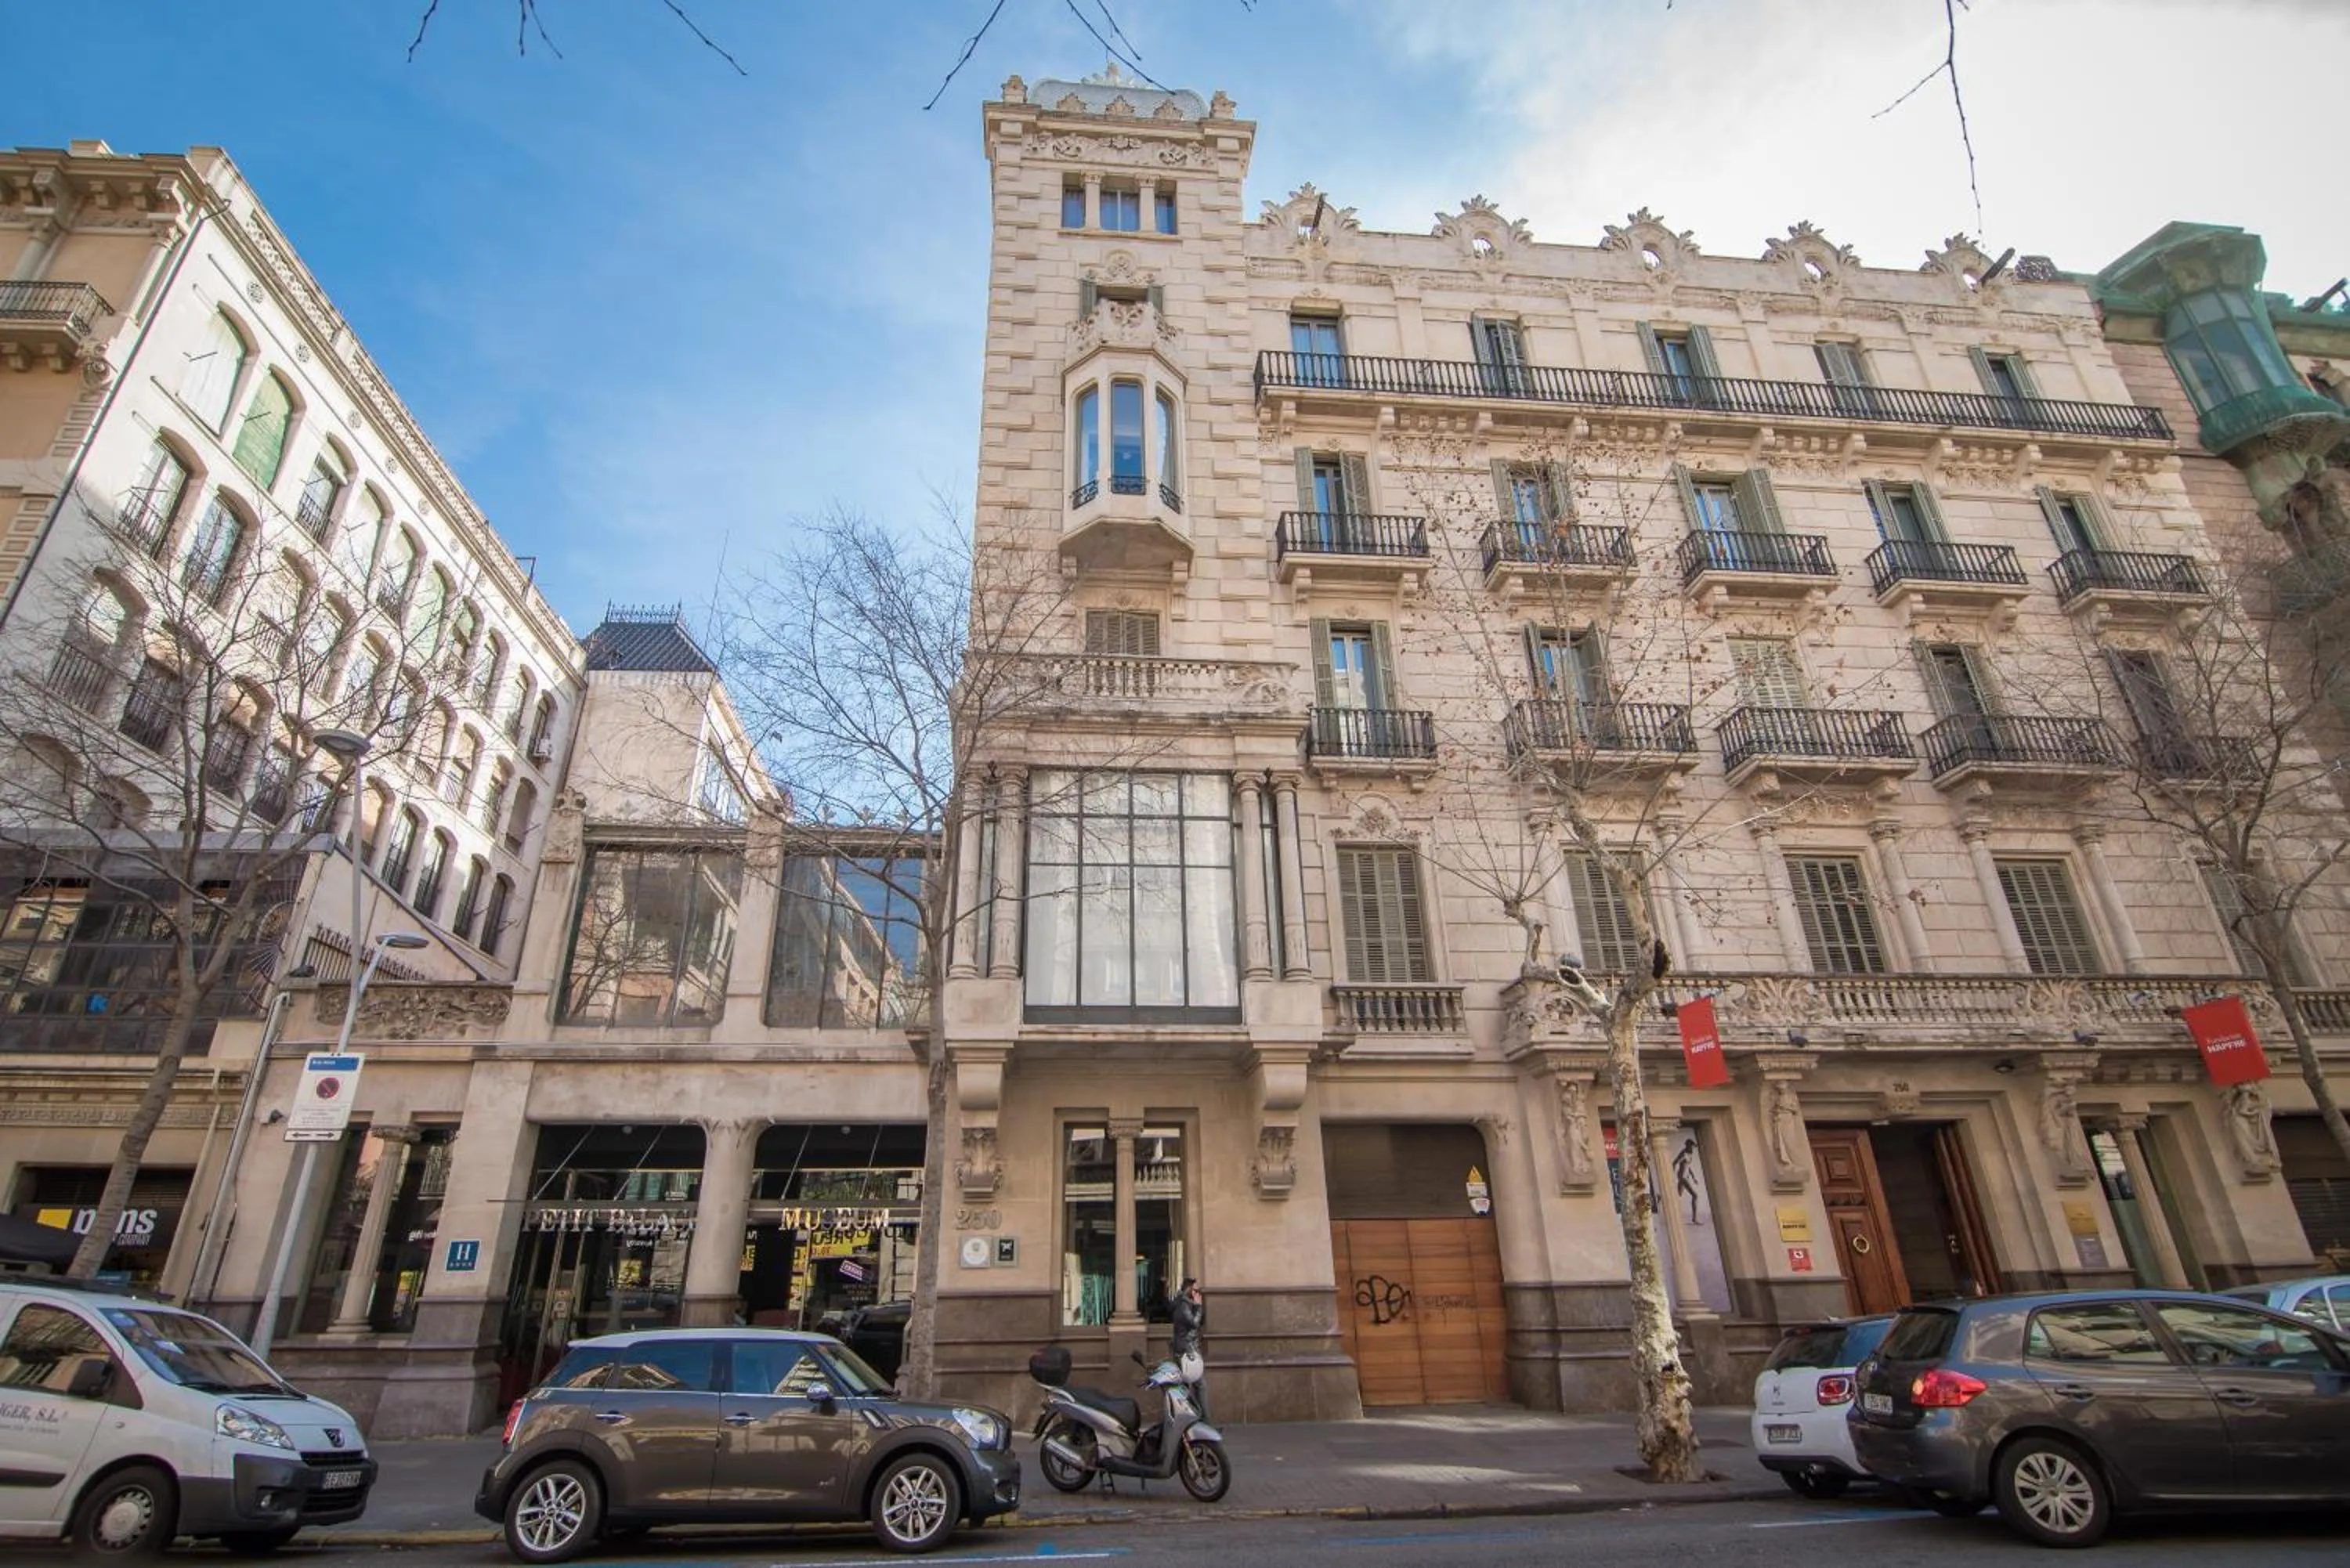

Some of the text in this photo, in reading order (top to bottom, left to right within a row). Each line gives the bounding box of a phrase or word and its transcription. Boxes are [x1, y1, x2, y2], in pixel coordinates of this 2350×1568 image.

[73, 1209, 157, 1234] pns
[522, 1209, 697, 1232] PETIT PALAC
[779, 1207, 890, 1230] MUSEUM
[954, 1208, 1002, 1230] 250
[457, 1243, 471, 1261] H
